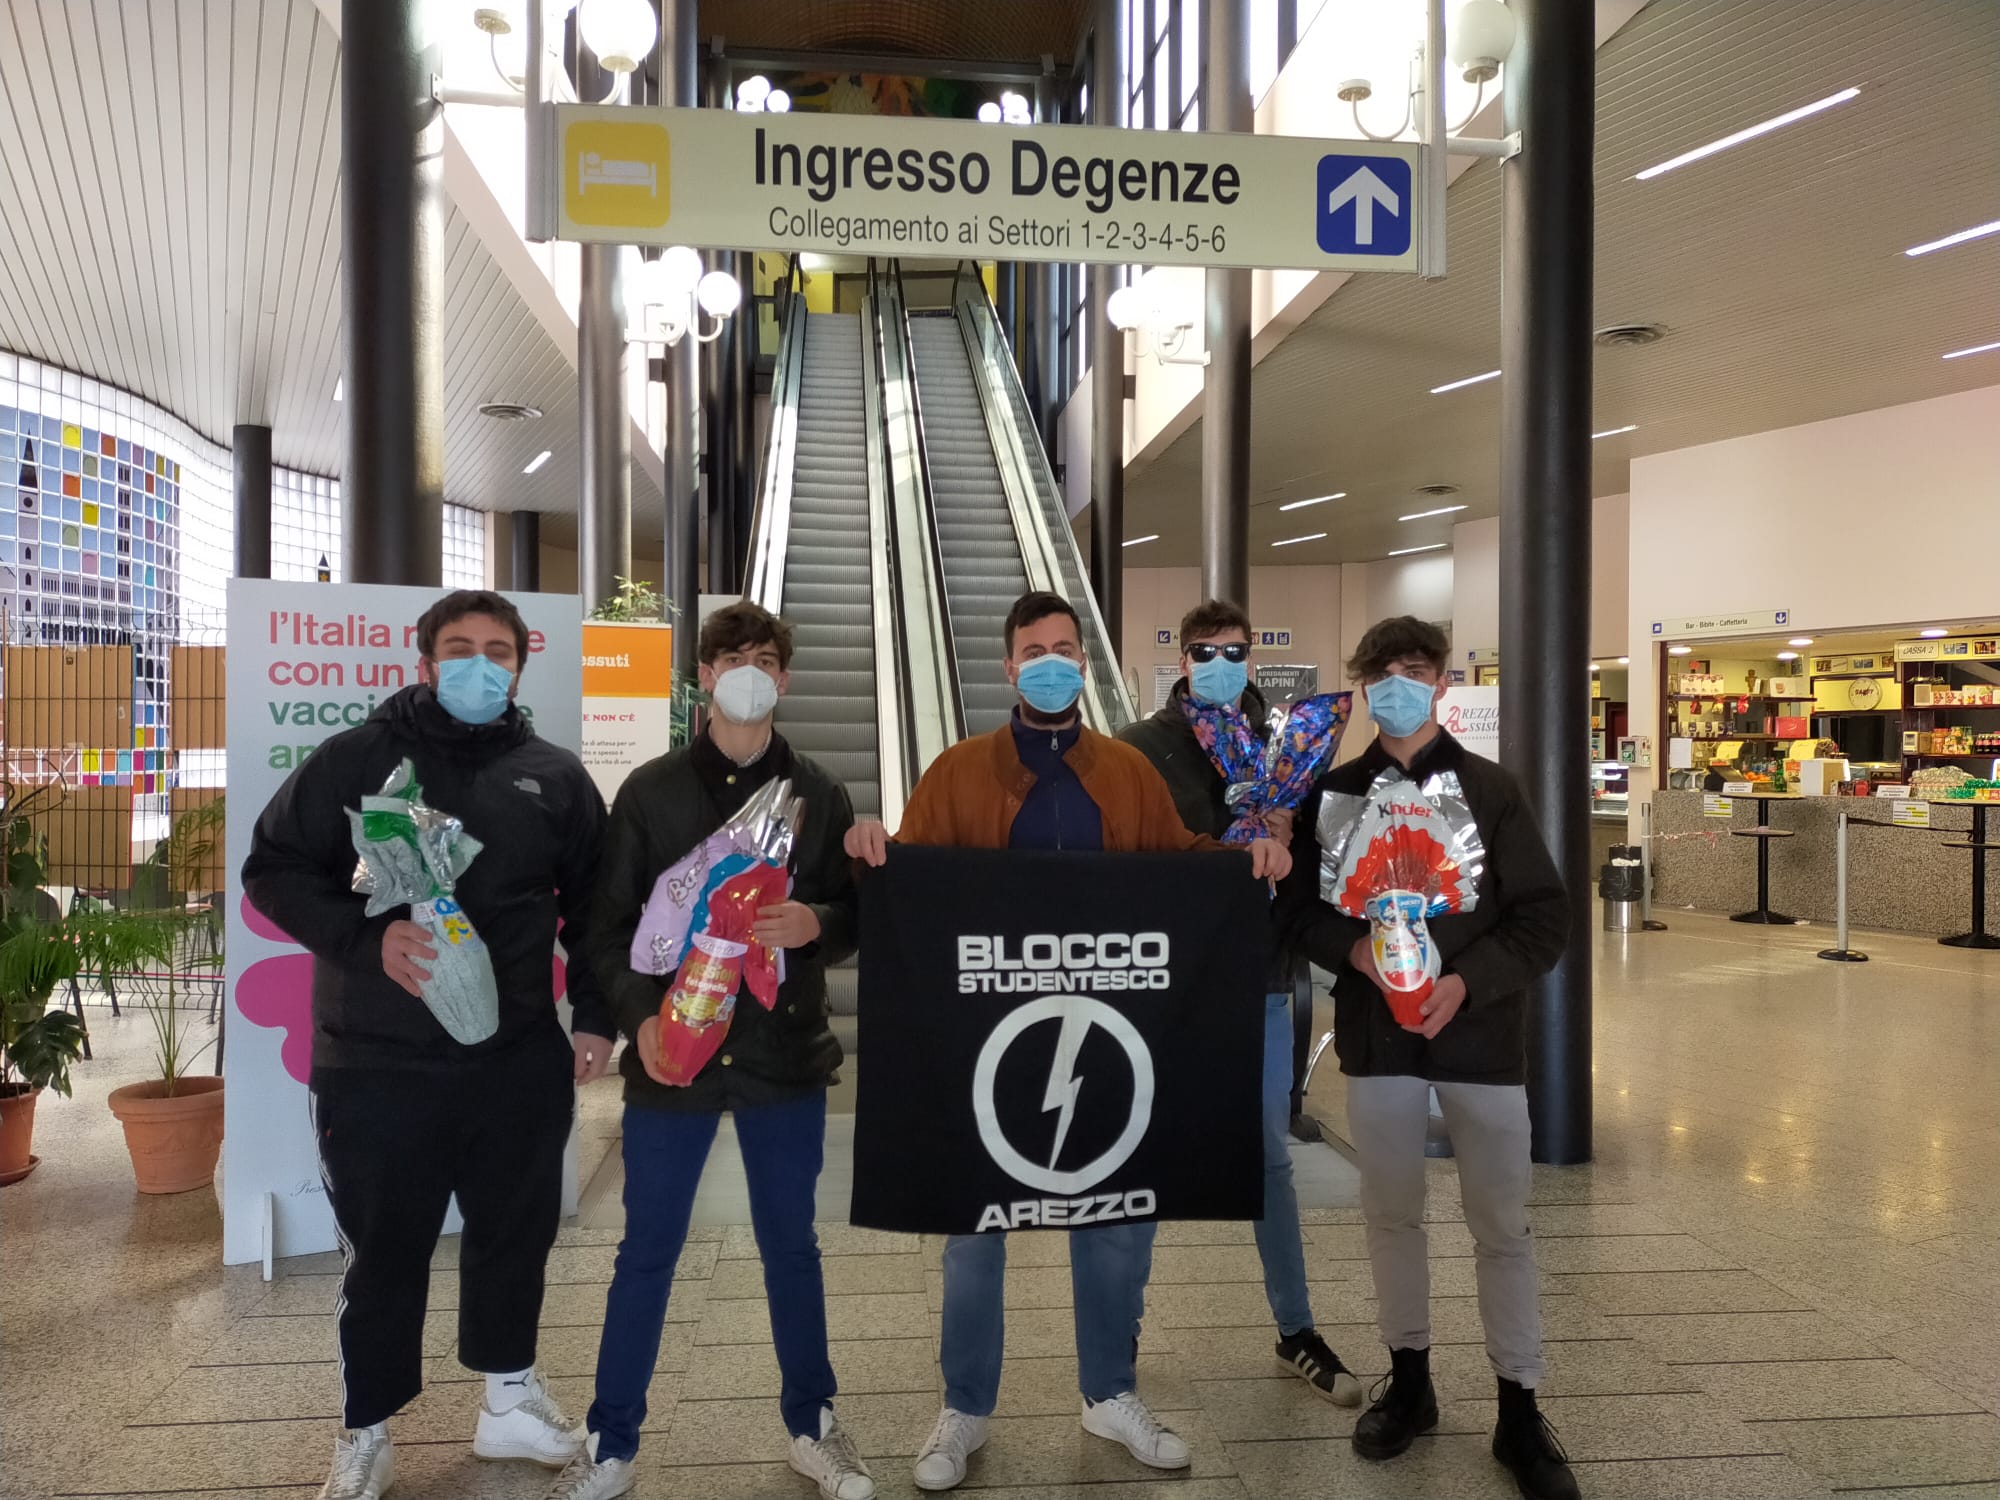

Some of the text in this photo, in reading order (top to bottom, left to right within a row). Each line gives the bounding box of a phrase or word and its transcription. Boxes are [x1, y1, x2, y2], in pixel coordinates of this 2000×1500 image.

[755, 128, 1241, 214] Ingresso Degenze
[768, 206, 1226, 253] Collegamento ai Settori 1-2-3-4-5-6
[1685, 622, 1694, 630] Bar
[1719, 617, 1748, 627] Caffetteria
[1902, 645, 1934, 655] CASSA 2
[268, 661, 344, 687] con
[356, 664, 404, 688] un
[1257, 677, 1295, 688] LAPINI
[593, 713, 616, 721] NON
[1378, 801, 1433, 818] Kinder
[957, 932, 1170, 970] BLOCCO
[957, 969, 1170, 994] STUDENTESCO
[975, 1189, 1156, 1233] AREZZO
